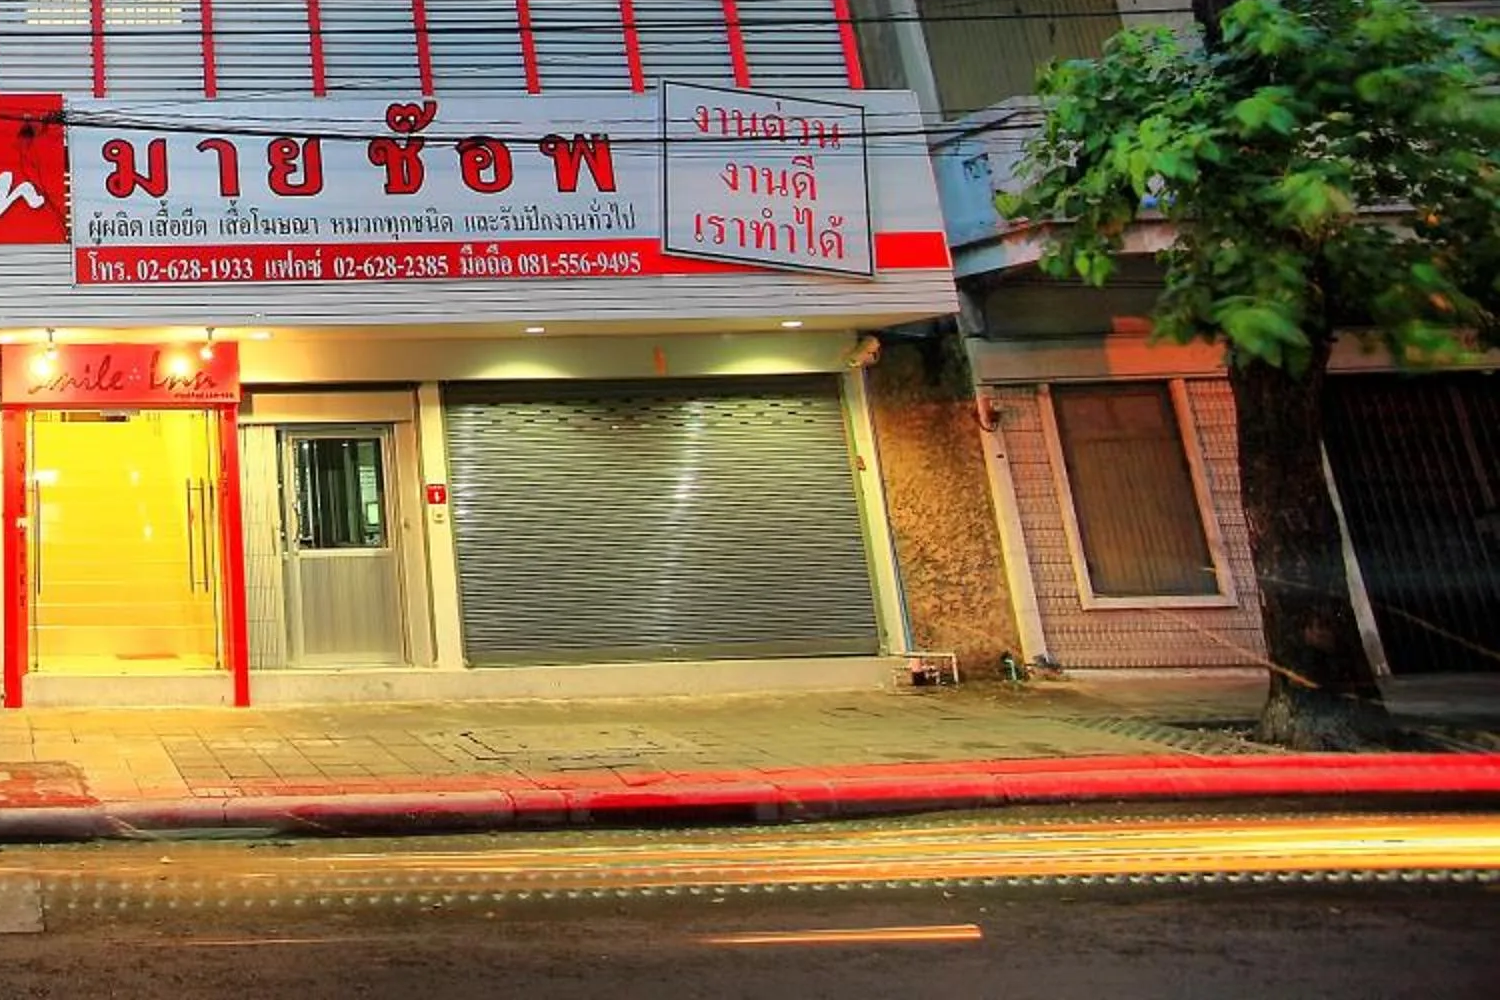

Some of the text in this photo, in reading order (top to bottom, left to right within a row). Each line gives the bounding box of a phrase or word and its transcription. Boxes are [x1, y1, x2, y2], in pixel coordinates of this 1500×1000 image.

[691, 101, 842, 150] งานด่วน
[718, 155, 817, 201] งานดี
[87, 210, 143, 245] ผู้ผลิต
[149, 199, 208, 237] เสื้อยืด
[218, 198, 318, 237] เสื้อโฆษณา
[330, 207, 453, 240] หมวกทุกชนิด
[693, 205, 845, 259] เราทำได้
[87, 243, 641, 281] โทร. 02-628-1933 แฟกซ์ 02-628-2385 มือถือ 081-556-9495
